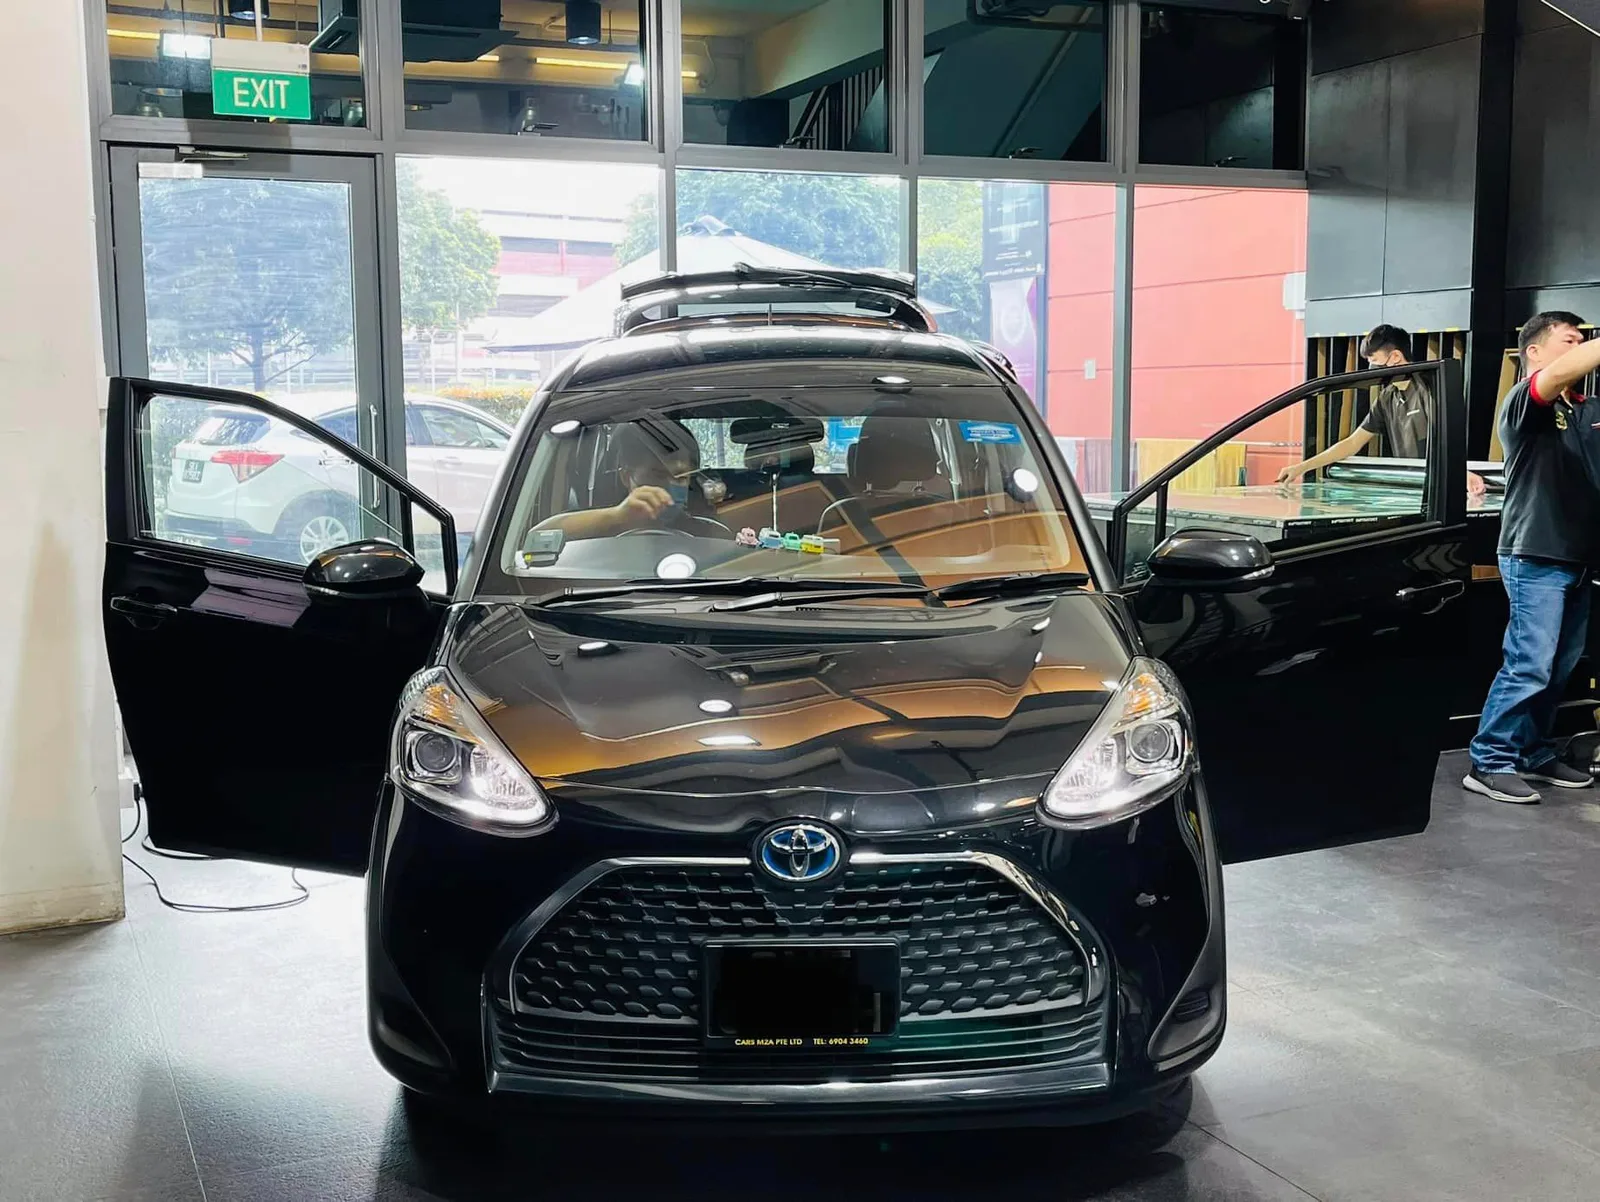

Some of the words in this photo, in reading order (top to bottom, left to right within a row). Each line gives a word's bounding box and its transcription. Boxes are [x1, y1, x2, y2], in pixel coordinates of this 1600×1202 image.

[233, 77, 290, 110] EXIT
[734, 1038, 755, 1046] CARS
[775, 1038, 788, 1046] PTE
[789, 1038, 803, 1046] LTD
[813, 1037, 827, 1045] TEL:
[828, 1037, 848, 1045] 6904
[849, 1037, 869, 1045] 3460
